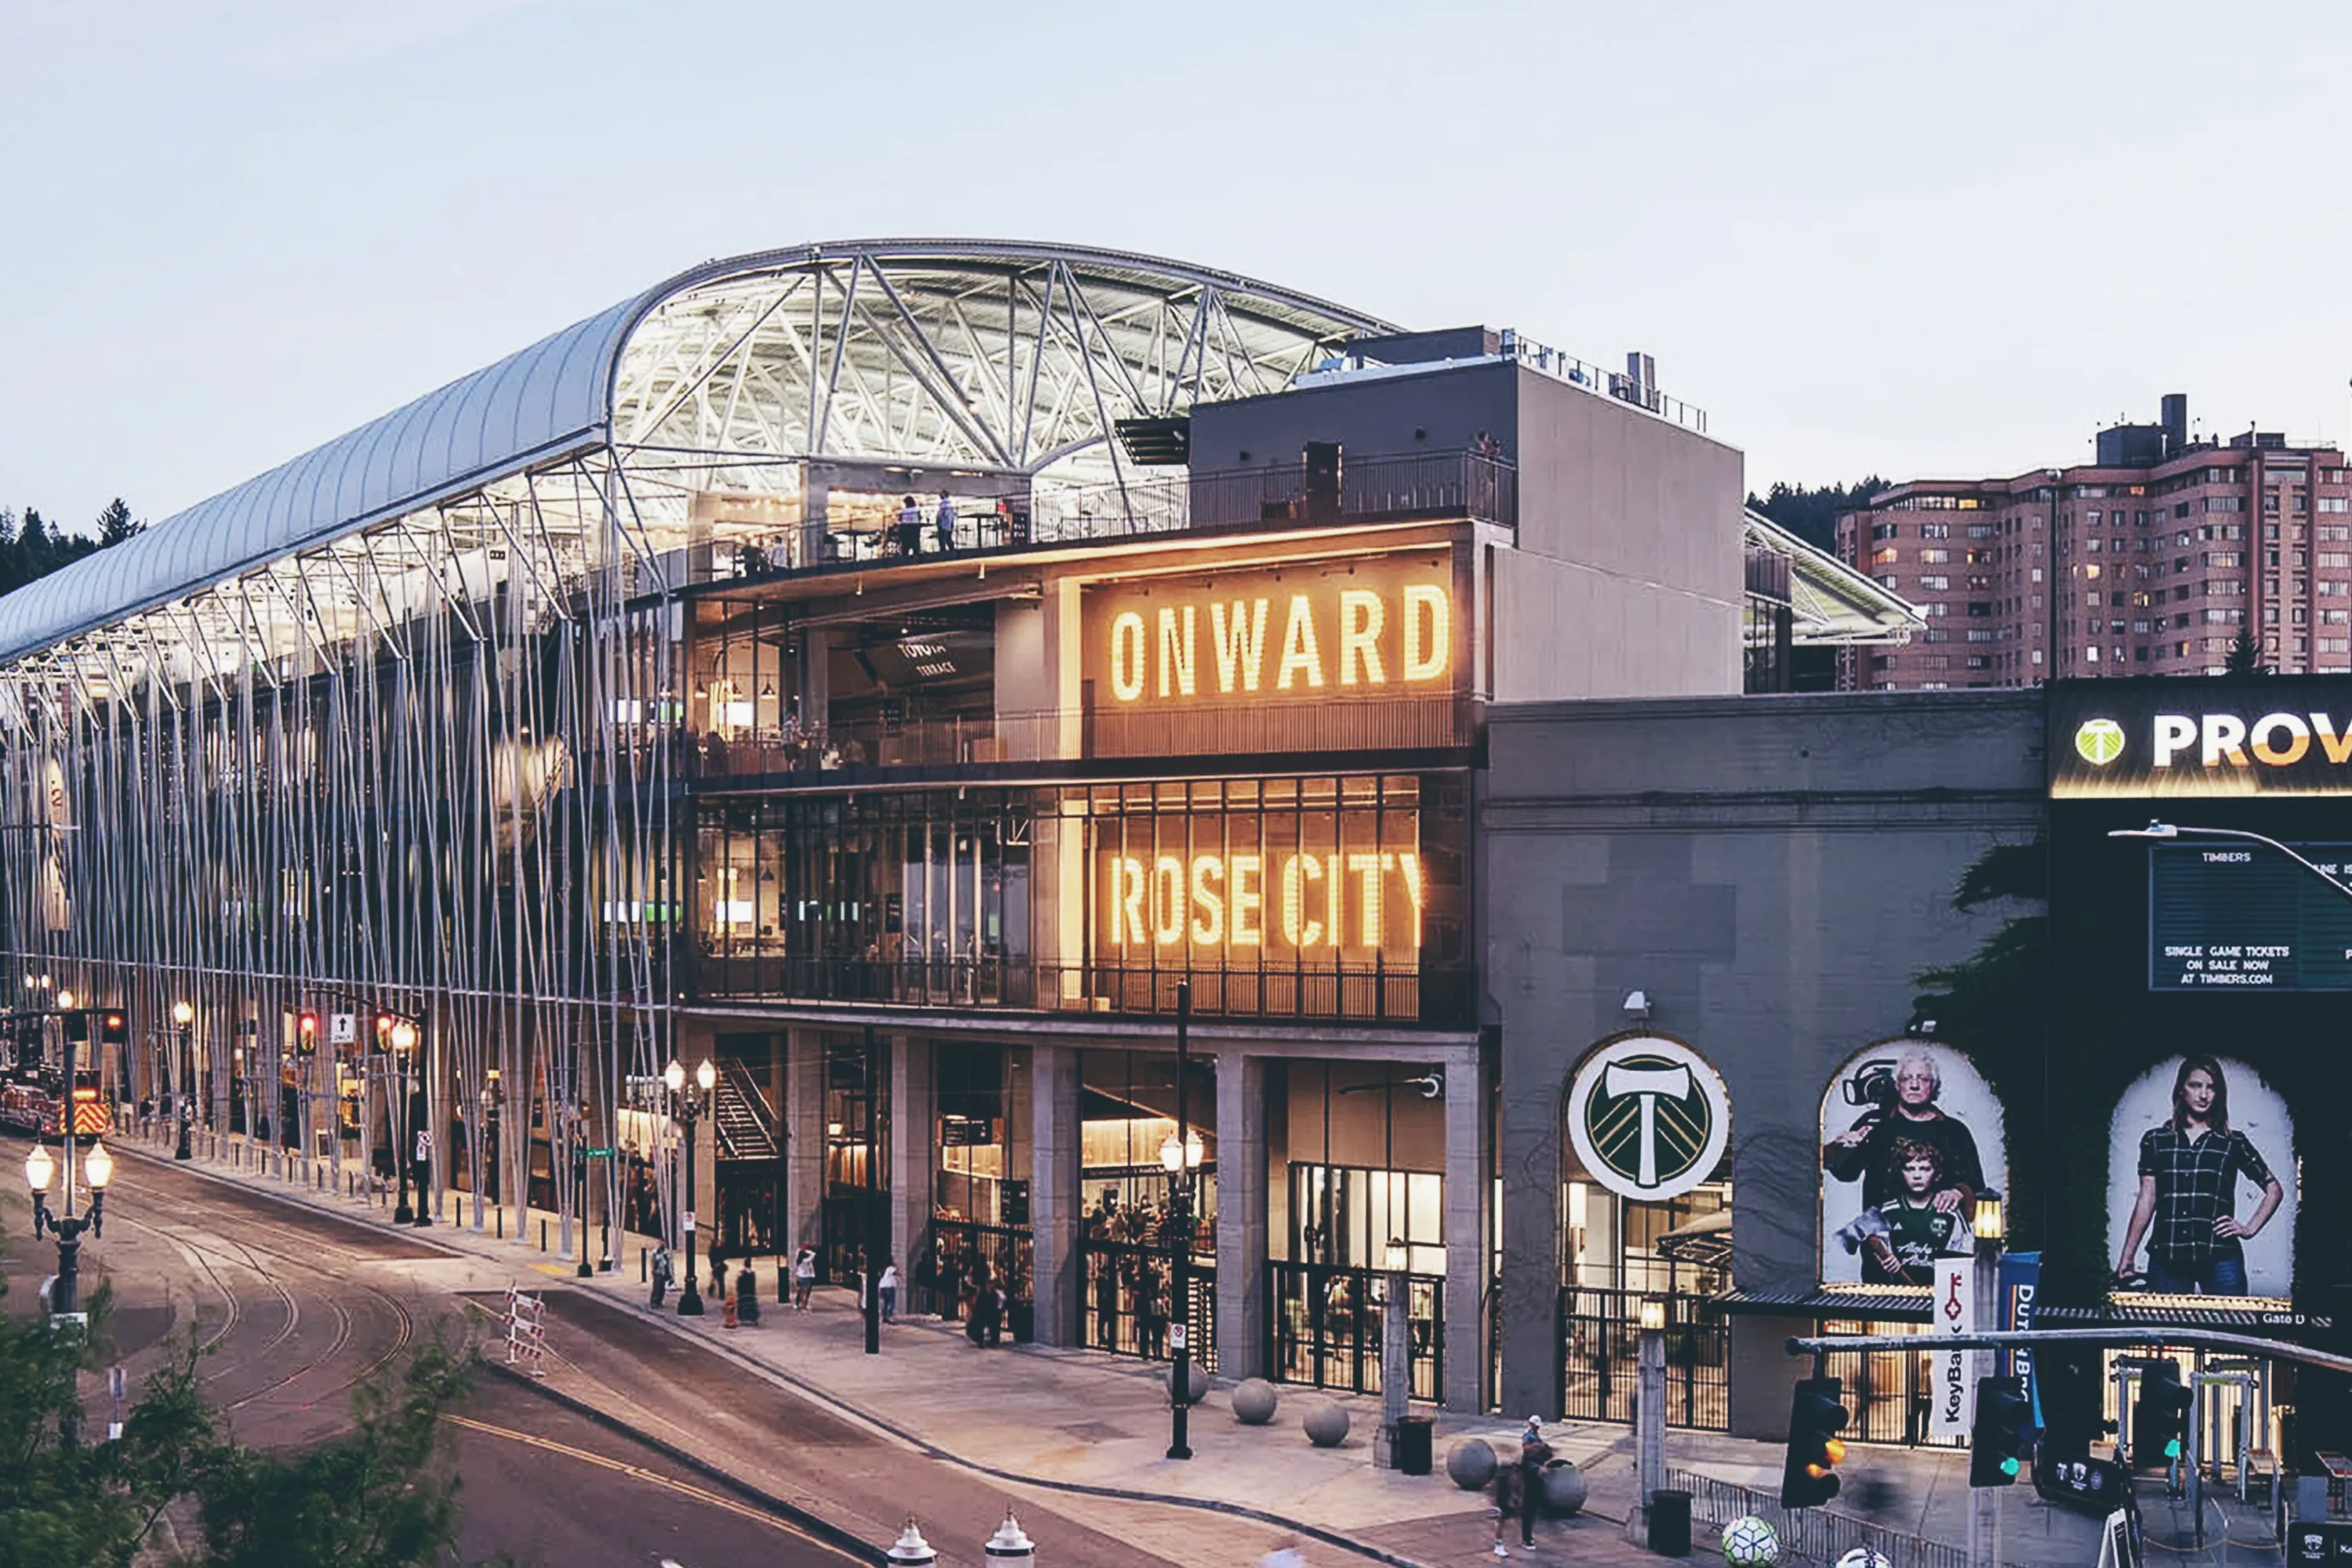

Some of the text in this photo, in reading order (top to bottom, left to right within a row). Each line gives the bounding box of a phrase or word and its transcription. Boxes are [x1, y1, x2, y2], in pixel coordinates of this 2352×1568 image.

[1111, 584, 1450, 702] ONWARD
[2154, 713, 2352, 767] PROV
[2202, 852, 2252, 862] TIMBERS
[1112, 853, 1422, 947] ROSE CITY
[2165, 946, 2290, 956] SINGLE GAME TICKETS
[2186, 960, 2270, 970] ON SALE NOW
[2181, 974, 2273, 984] AT TIMBERS.COM
[2263, 1313, 2292, 1323] Gate
[1945, 1325, 1964, 1423] KeyBa
